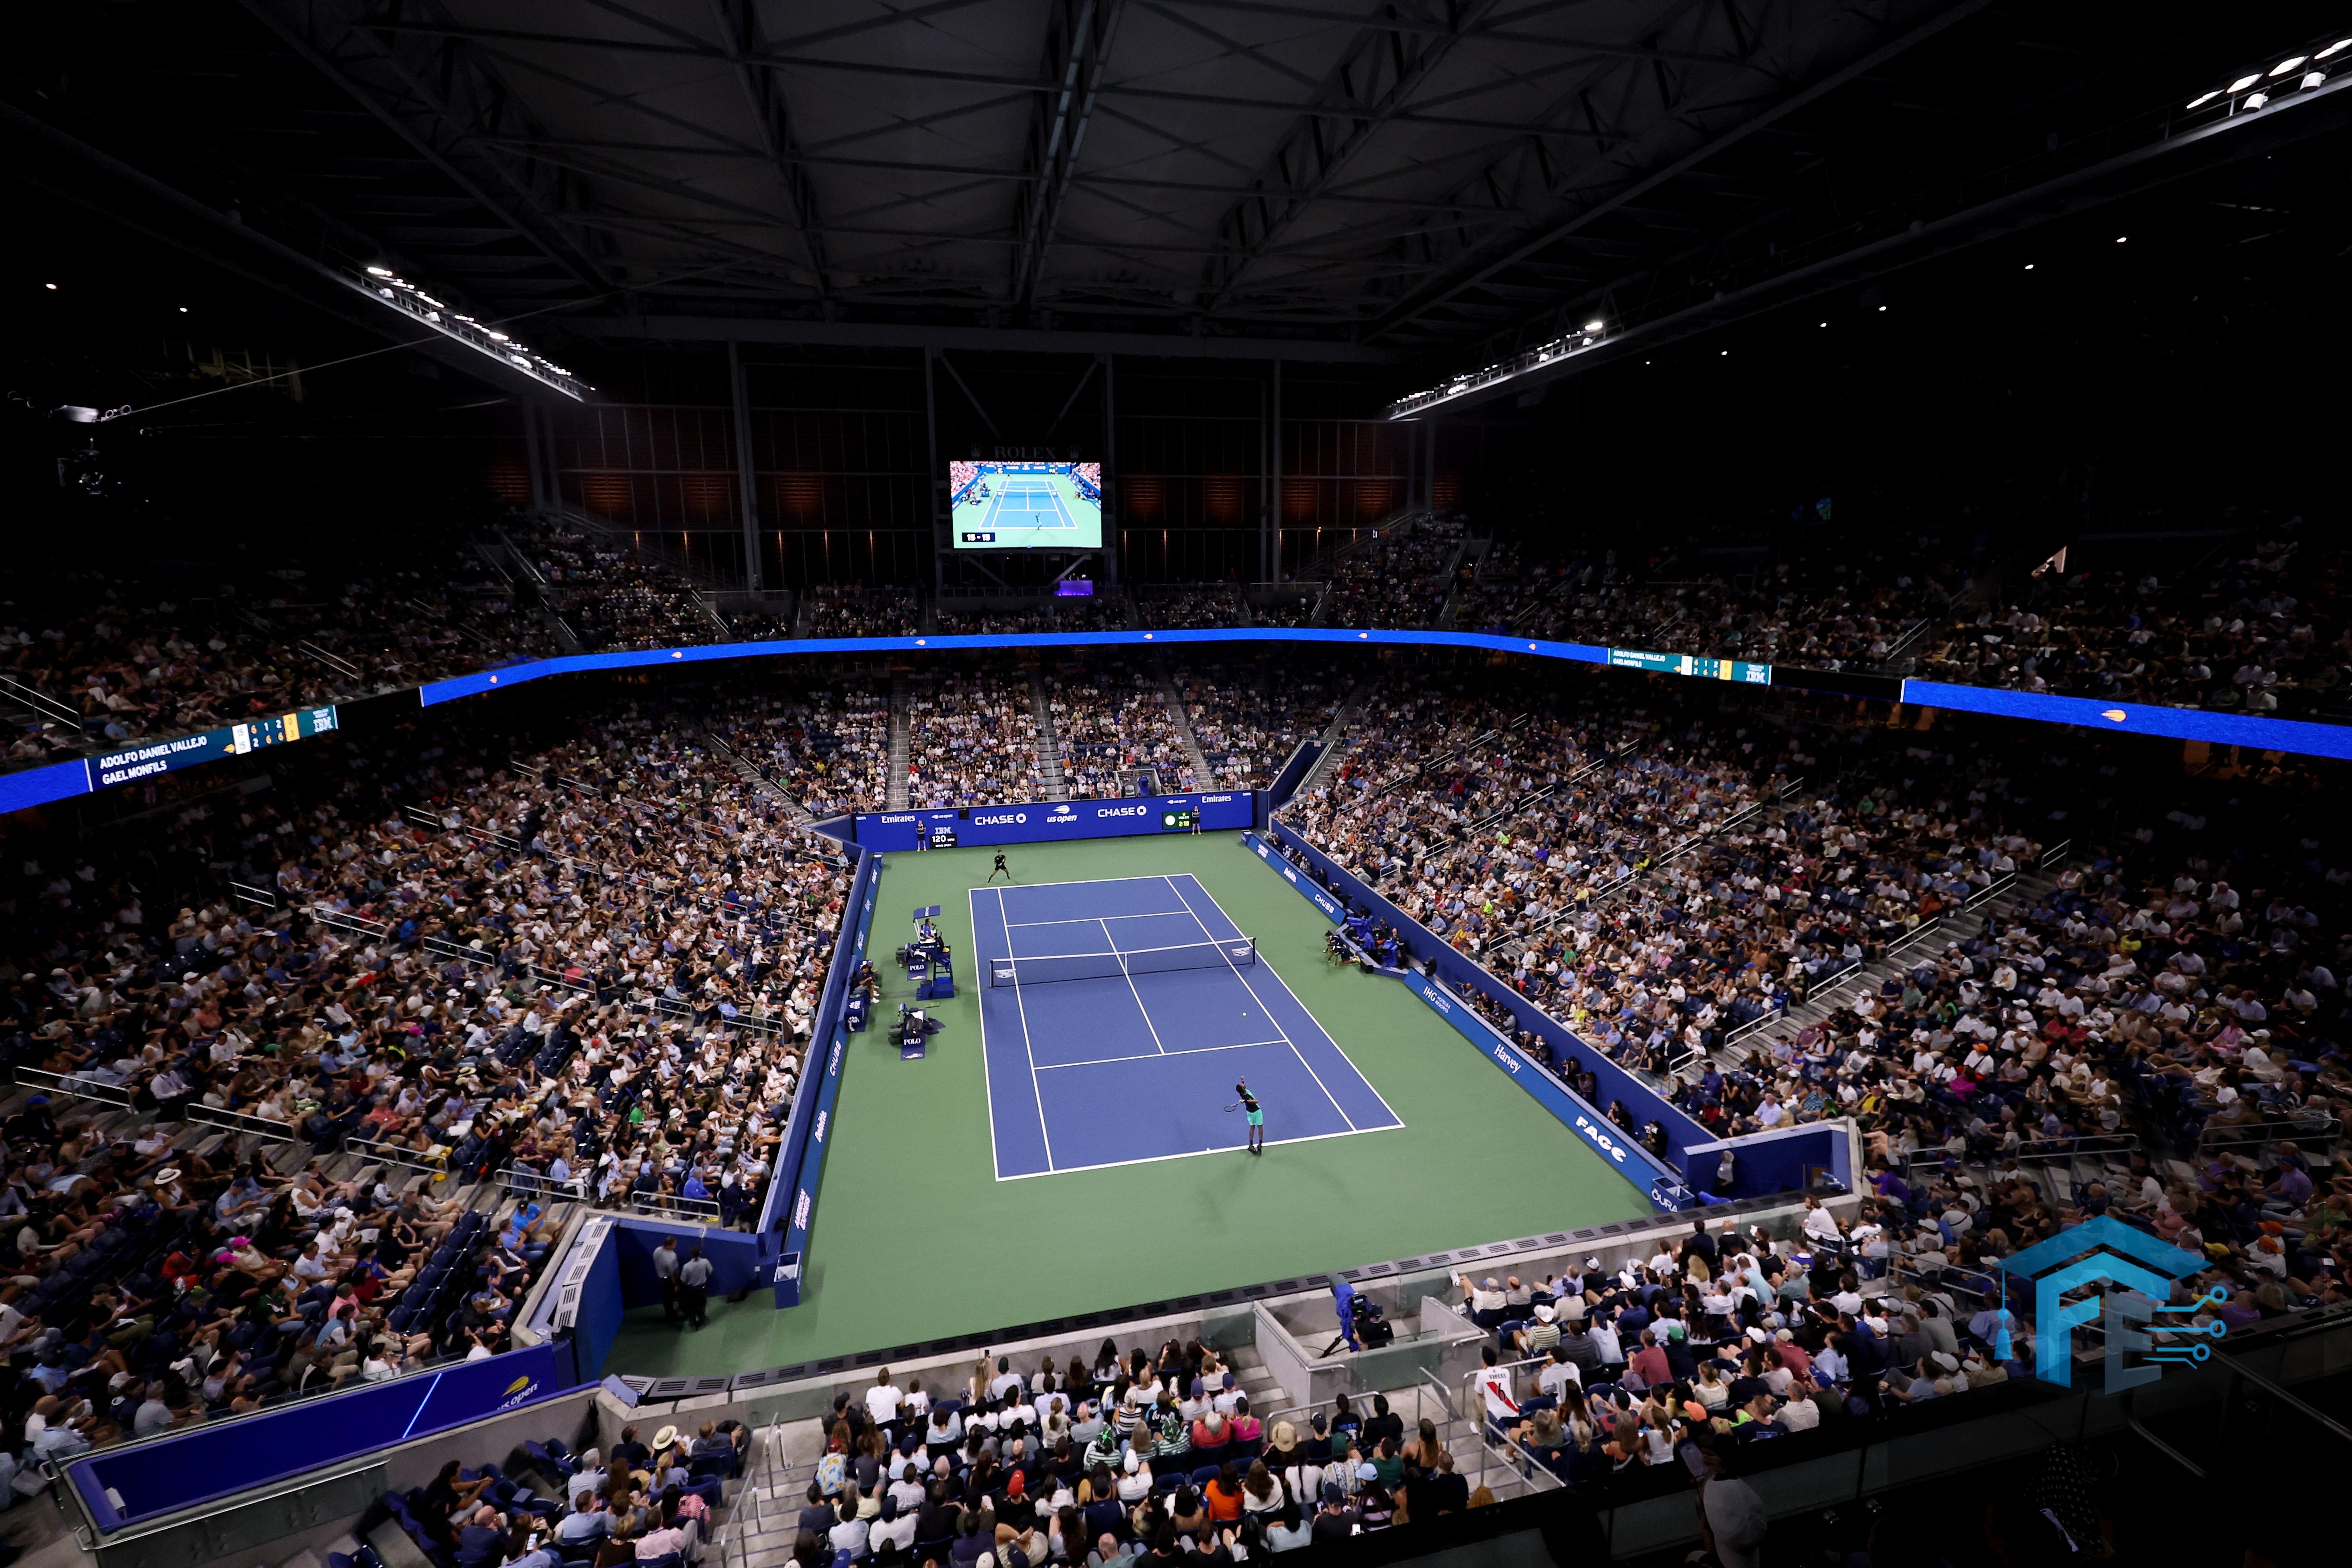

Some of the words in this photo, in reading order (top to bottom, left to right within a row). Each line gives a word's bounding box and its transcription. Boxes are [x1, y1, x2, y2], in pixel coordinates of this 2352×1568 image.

[993, 446, 1056, 459] ROLEX
[1746, 670, 1765, 683] IBM
[313, 716, 333, 732] IBM
[100, 751, 138, 769] ADOLFO
[138, 744, 171, 760] DANIEL
[170, 736, 207, 752] VALLEJO
[264, 722, 269, 731] 1
[276, 719, 282, 729] 2
[102, 769, 129, 784] GAEL
[128, 760, 167, 778] MONFILS
[253, 738, 259, 747] 2
[1202, 795, 1232, 804] Emirates
[881, 815, 915, 824] Emirates
[975, 815, 1015, 825] CHASE
[1057, 815, 1077, 824] open
[1097, 807, 1135, 818] CHASE
[1315, 894, 1335, 913] CHUBB
[830, 1040, 841, 1076] CHUBB
[1494, 1044, 1521, 1074] Harvey
[814, 1110, 827, 1143] Deloitte
[795, 1188, 806, 1229] AMERICAN
[799, 1194, 810, 1230] EXPRESS
[510, 1383, 538, 1405] open
[1498, 1383, 1506, 1401] 6
